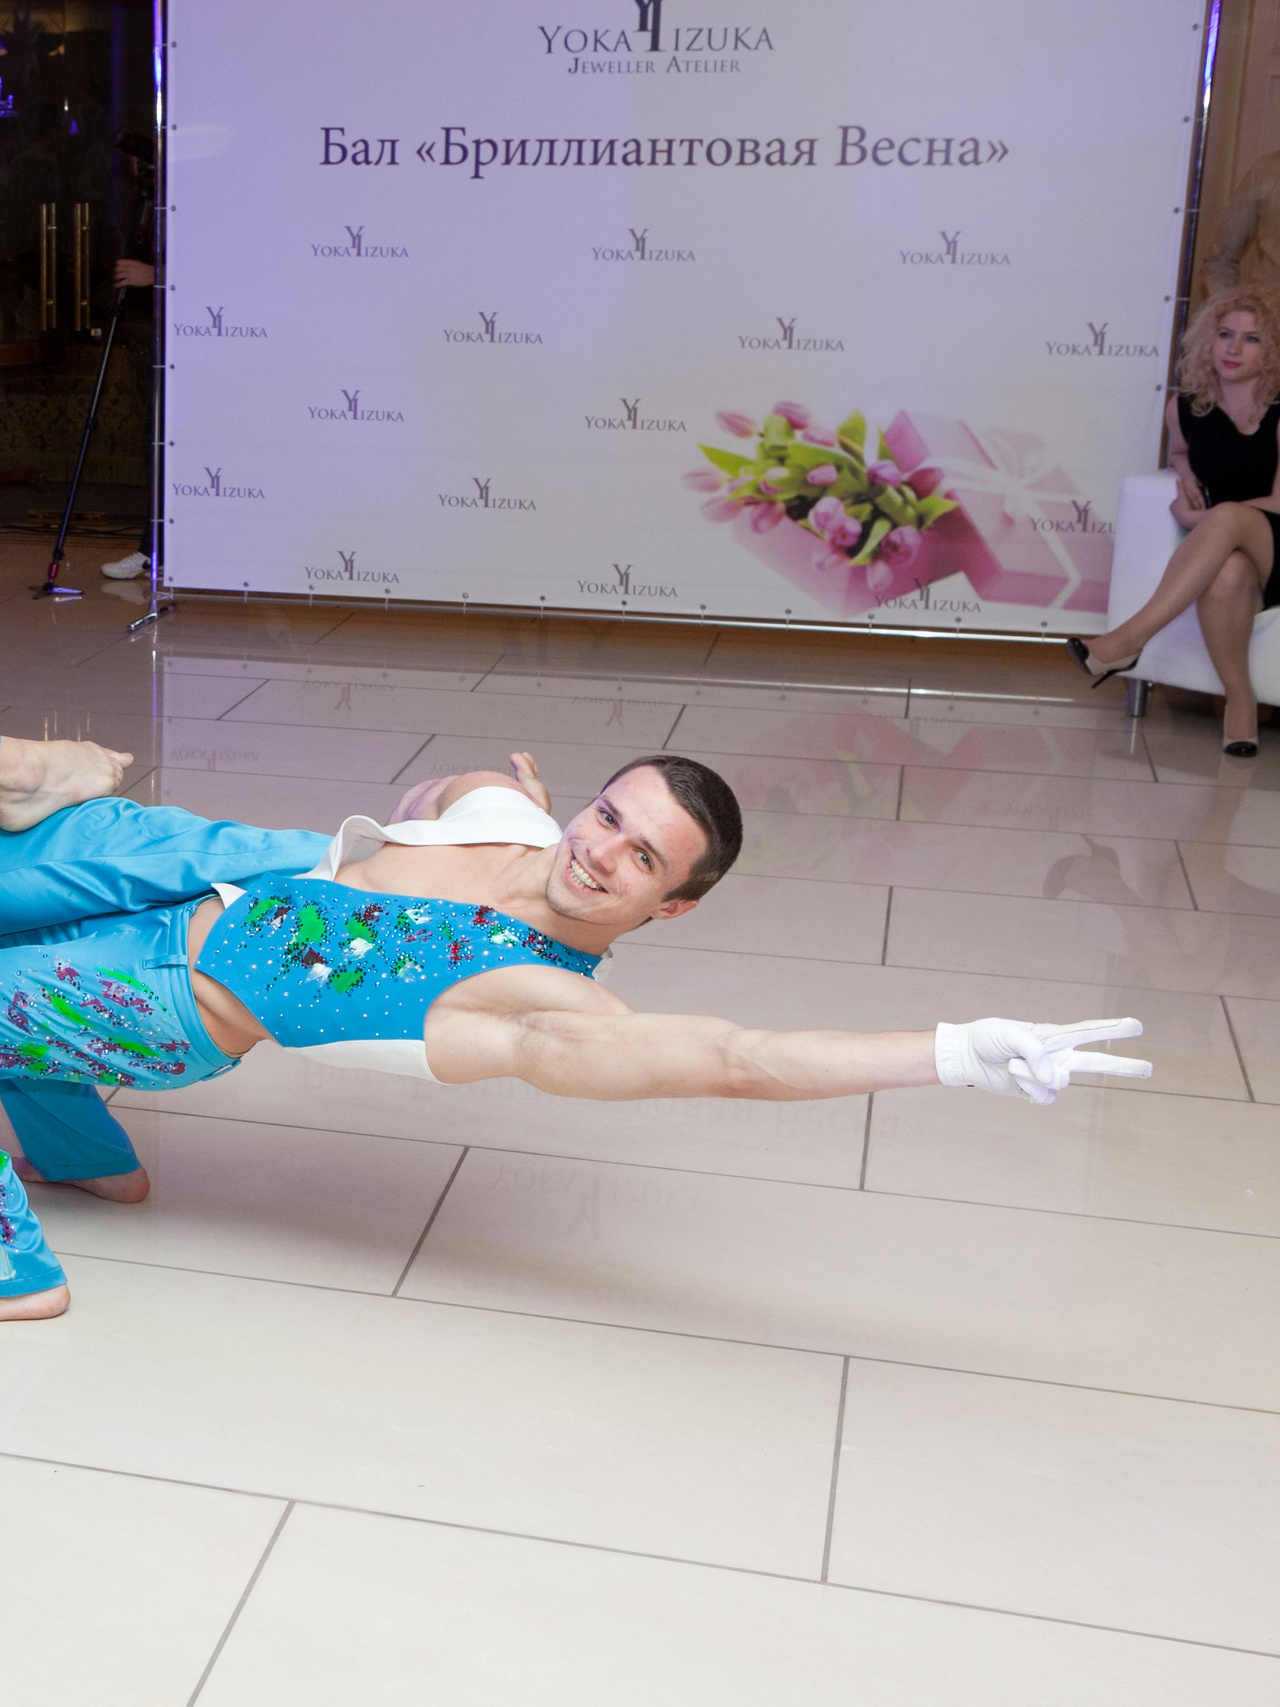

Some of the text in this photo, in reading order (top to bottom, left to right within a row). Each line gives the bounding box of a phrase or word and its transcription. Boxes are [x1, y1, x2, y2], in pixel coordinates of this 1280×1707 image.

[538, 25, 632, 54] YOKA
[673, 27, 775, 52] IZUKA
[568, 55, 741, 74] JEWELLER ATELIER
[320, 125, 1010, 180] Бал «Бриллиантовая Весна»
[311, 244, 351, 258] YOKA
[365, 246, 409, 259] IZUKA
[592, 247, 633, 261] YOKA
[649, 249, 696, 262] IZUKA
[900, 251, 945, 265] YOKA
[961, 252, 1011, 266] IZUKA
[173, 323, 212, 337] YOKA
[225, 325, 267, 338] IZUKA
[443, 330, 484, 344] YOKA
[498, 331, 543, 345] IZUKA
[738, 336, 782, 350] YOKA
[795, 338, 845, 351] IZUKA
[1046, 342, 1091, 356] YOKA
[1107, 343, 1159, 357] IZUKA
[308, 407, 347, 420] YOKA
[361, 410, 404, 422] IZUKA
[585, 416, 626, 430] YOKA
[641, 419, 687, 432] IZUKA
[172, 483, 210, 497] YOKA
[223, 486, 265, 499] IZUKA
[438, 494, 479, 508] YOKA
[492, 497, 537, 510] IZUKA
[1030, 517, 1076, 533] YOKA
[305, 567, 344, 581] YOKA
[357, 571, 400, 583] IZUKA
[578, 580, 618, 594] YOKA
[632, 584, 678, 598] IZUKA
